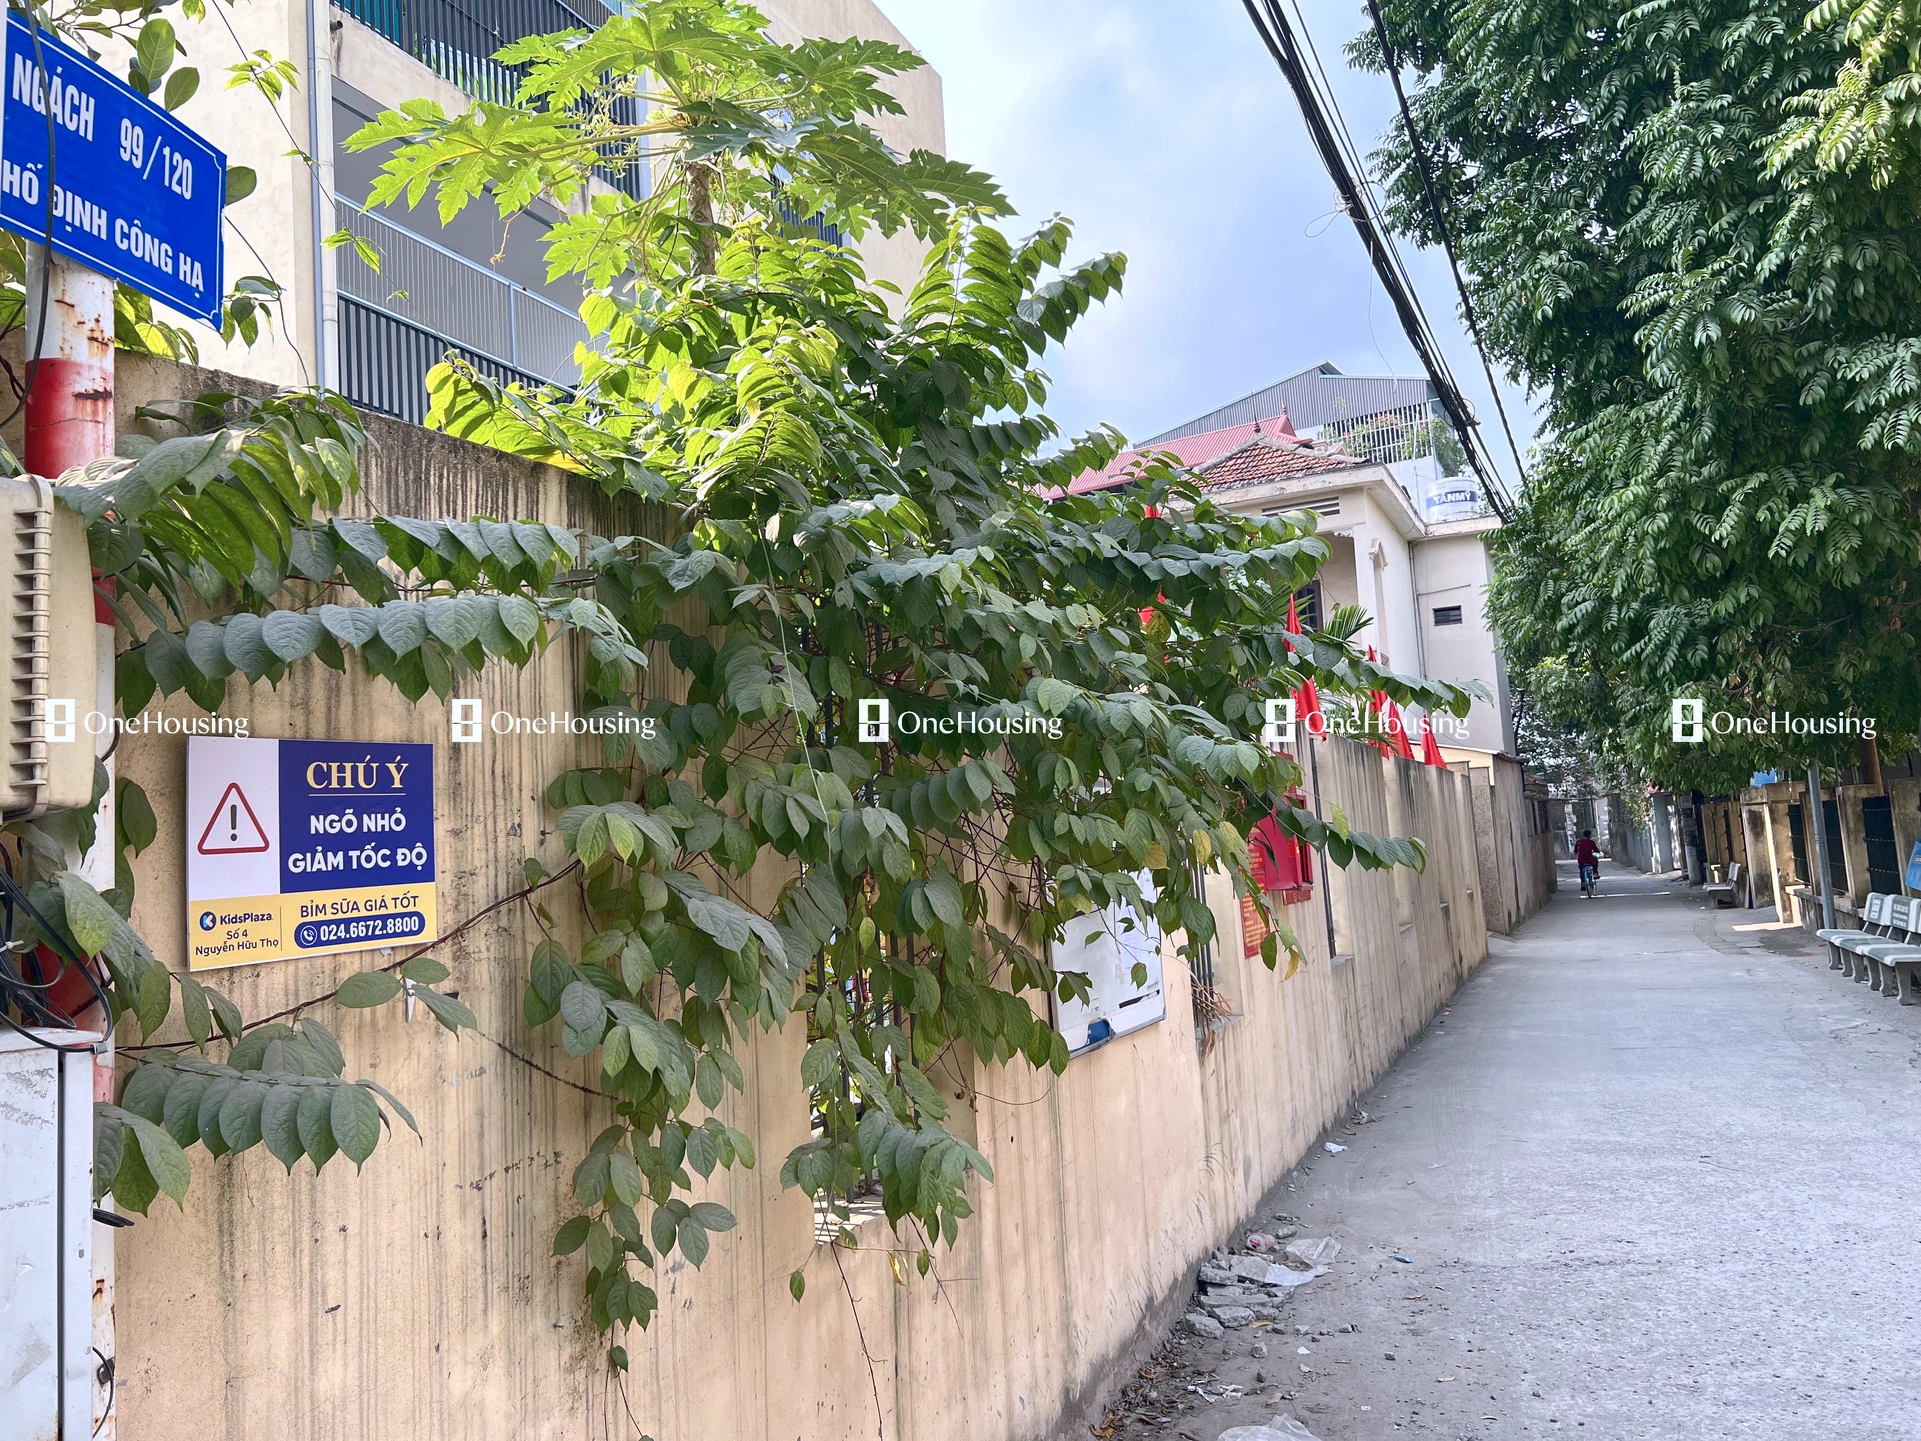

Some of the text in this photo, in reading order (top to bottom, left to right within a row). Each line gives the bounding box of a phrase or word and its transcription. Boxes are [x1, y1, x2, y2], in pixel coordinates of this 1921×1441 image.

[12, 53, 192, 200] NGÁCH 99/120
[2, 159, 204, 297] HỐ ĐỊNH CÔNG HẠ
[306, 754, 409, 789] CHÚ Ý
[310, 807, 406, 834] NGÕ NHỎ
[288, 842, 427, 873] GIẢM TỐC ĐỘ
[300, 891, 419, 918] BỈM SỮA GIÁ TỐT
[220, 912, 272, 925] KidsPlaza
[320, 915, 419, 941] 024.6672.8800
[195, 938, 279, 956] Nguyễn Hữu Thọ
[226, 928, 248, 940] Số 4
